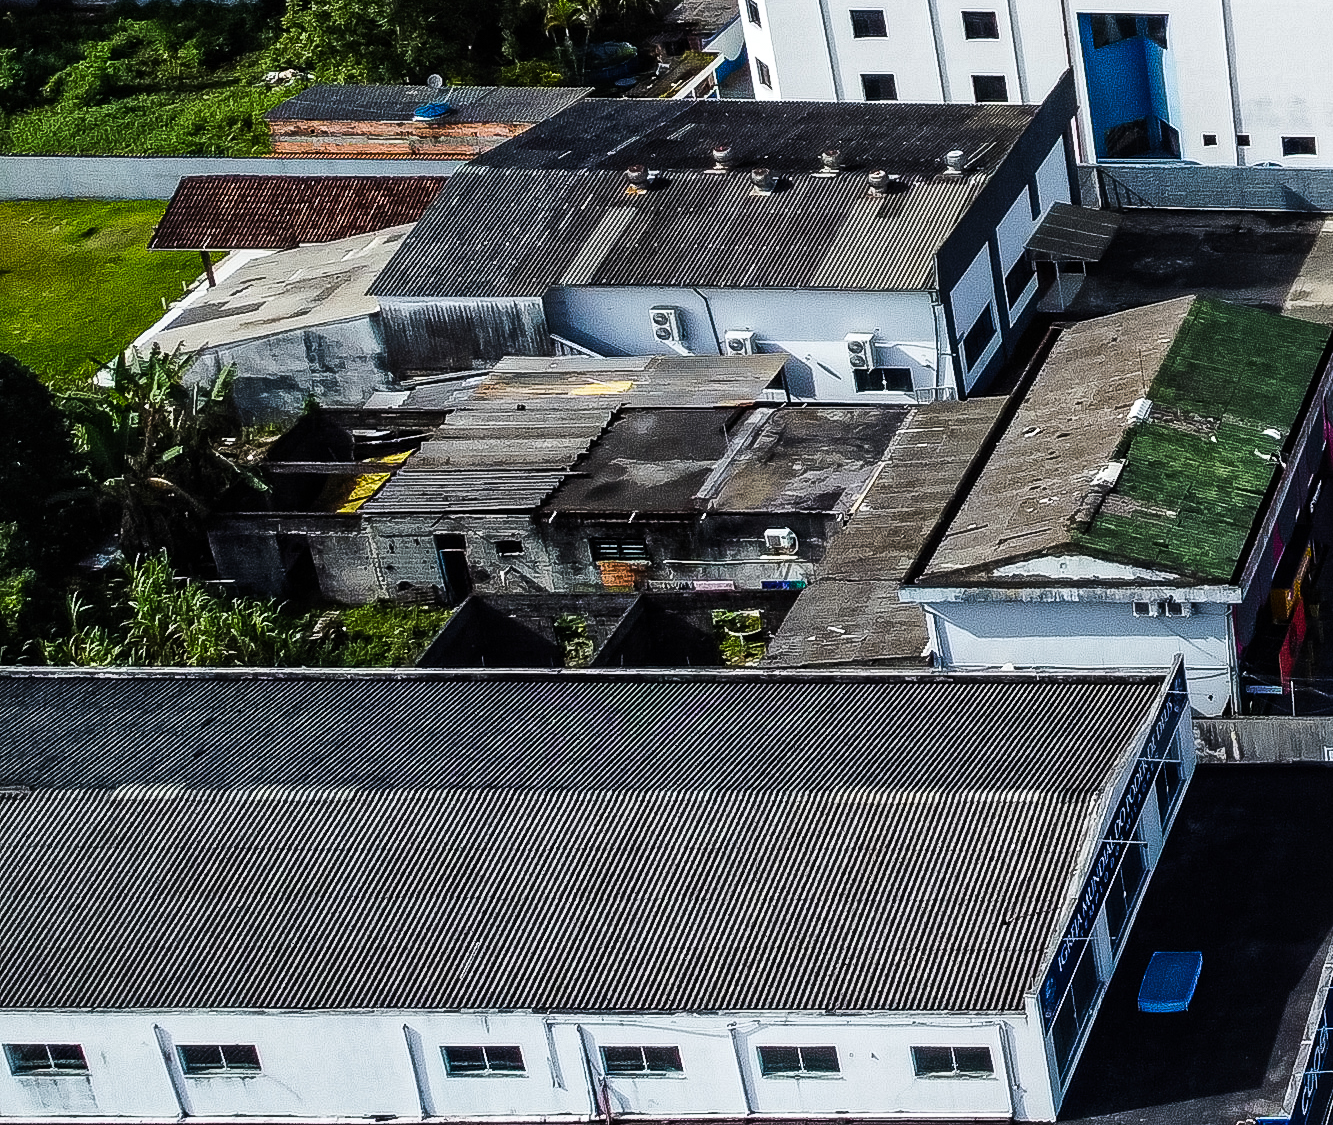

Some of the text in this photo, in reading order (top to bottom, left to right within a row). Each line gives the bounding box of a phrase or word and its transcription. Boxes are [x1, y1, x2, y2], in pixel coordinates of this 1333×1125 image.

[1057, 914, 1083, 972] IGREJA
[1083, 836, 1115, 913] MUNDIAL
[1125, 760, 1148, 813] PODER
